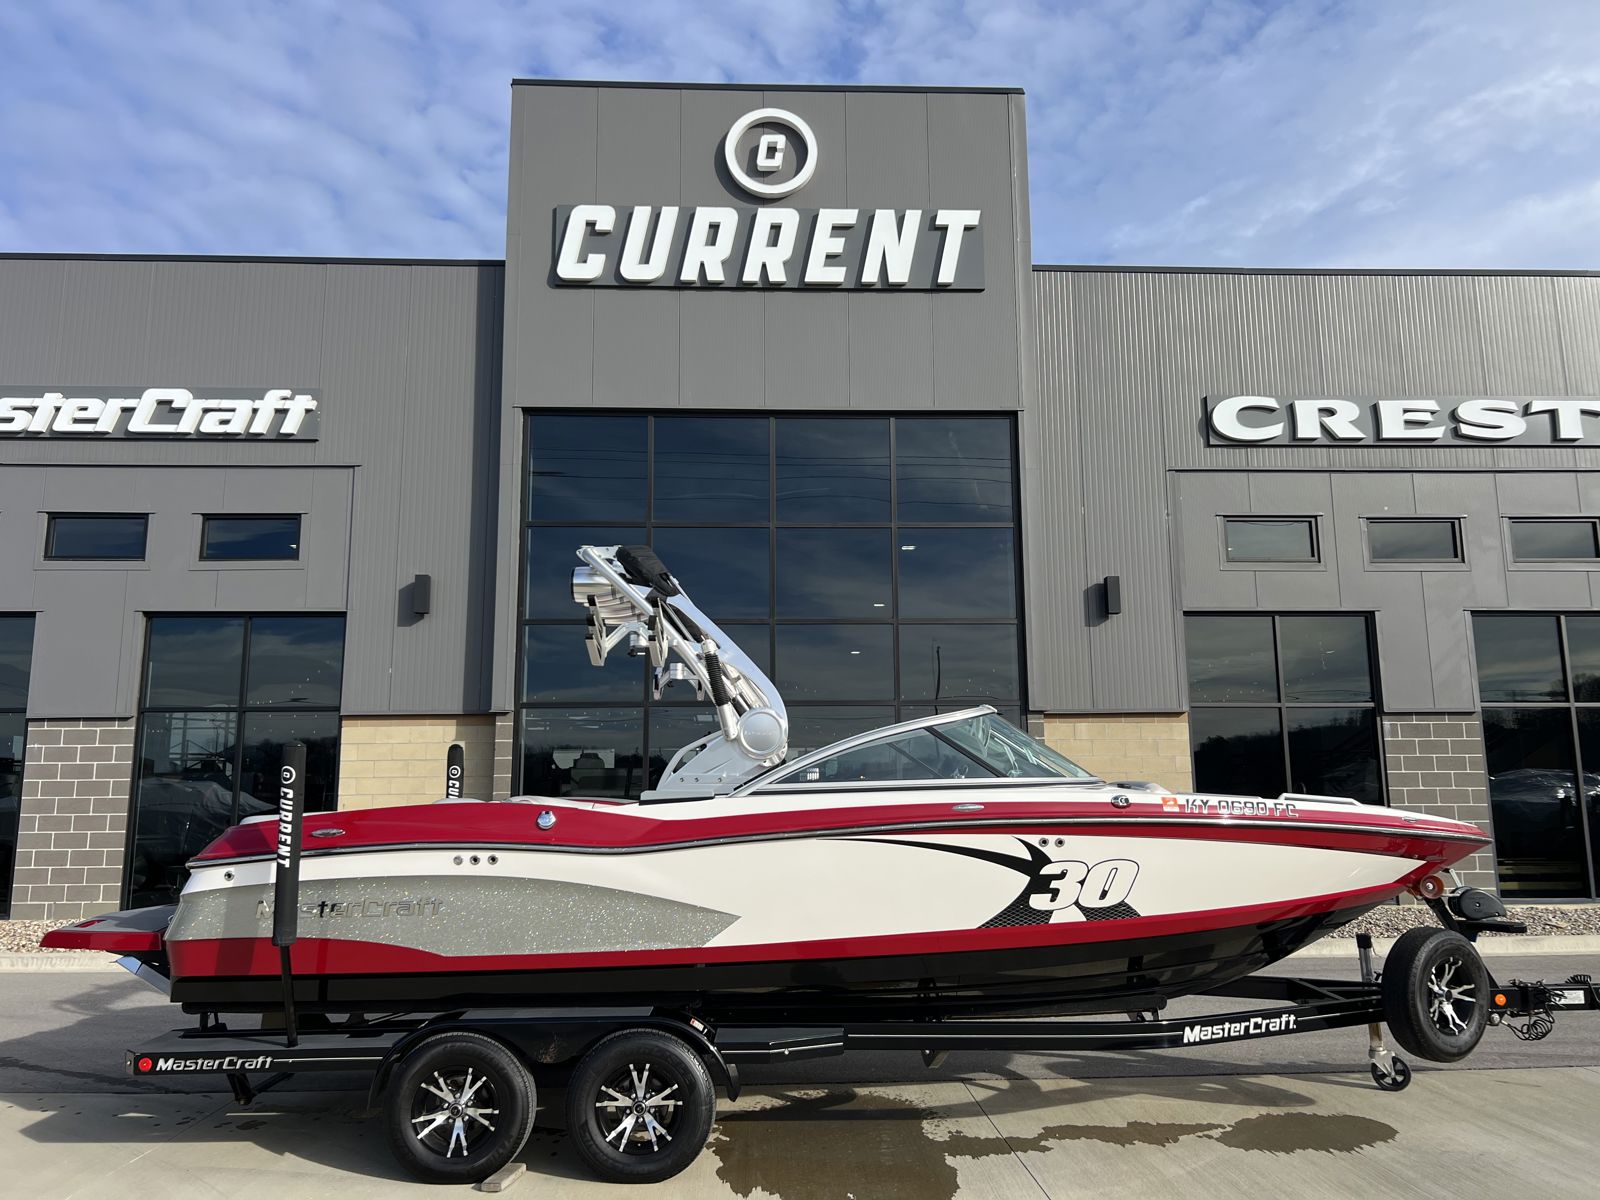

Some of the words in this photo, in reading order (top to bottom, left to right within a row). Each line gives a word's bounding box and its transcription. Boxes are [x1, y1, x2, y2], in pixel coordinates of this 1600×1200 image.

[556, 204, 981, 287] CURRENT
[1210, 395, 1600, 441] CREST
[448, 780, 460, 798] CU
[1185, 798, 1209, 813] KY
[1274, 802, 1299, 818] FC
[277, 787, 294, 868] CURRENT
[255, 898, 444, 919] MsterCraft
[1183, 1014, 1297, 1043] MasterCraft
[156, 1055, 273, 1071] MasterCraft
